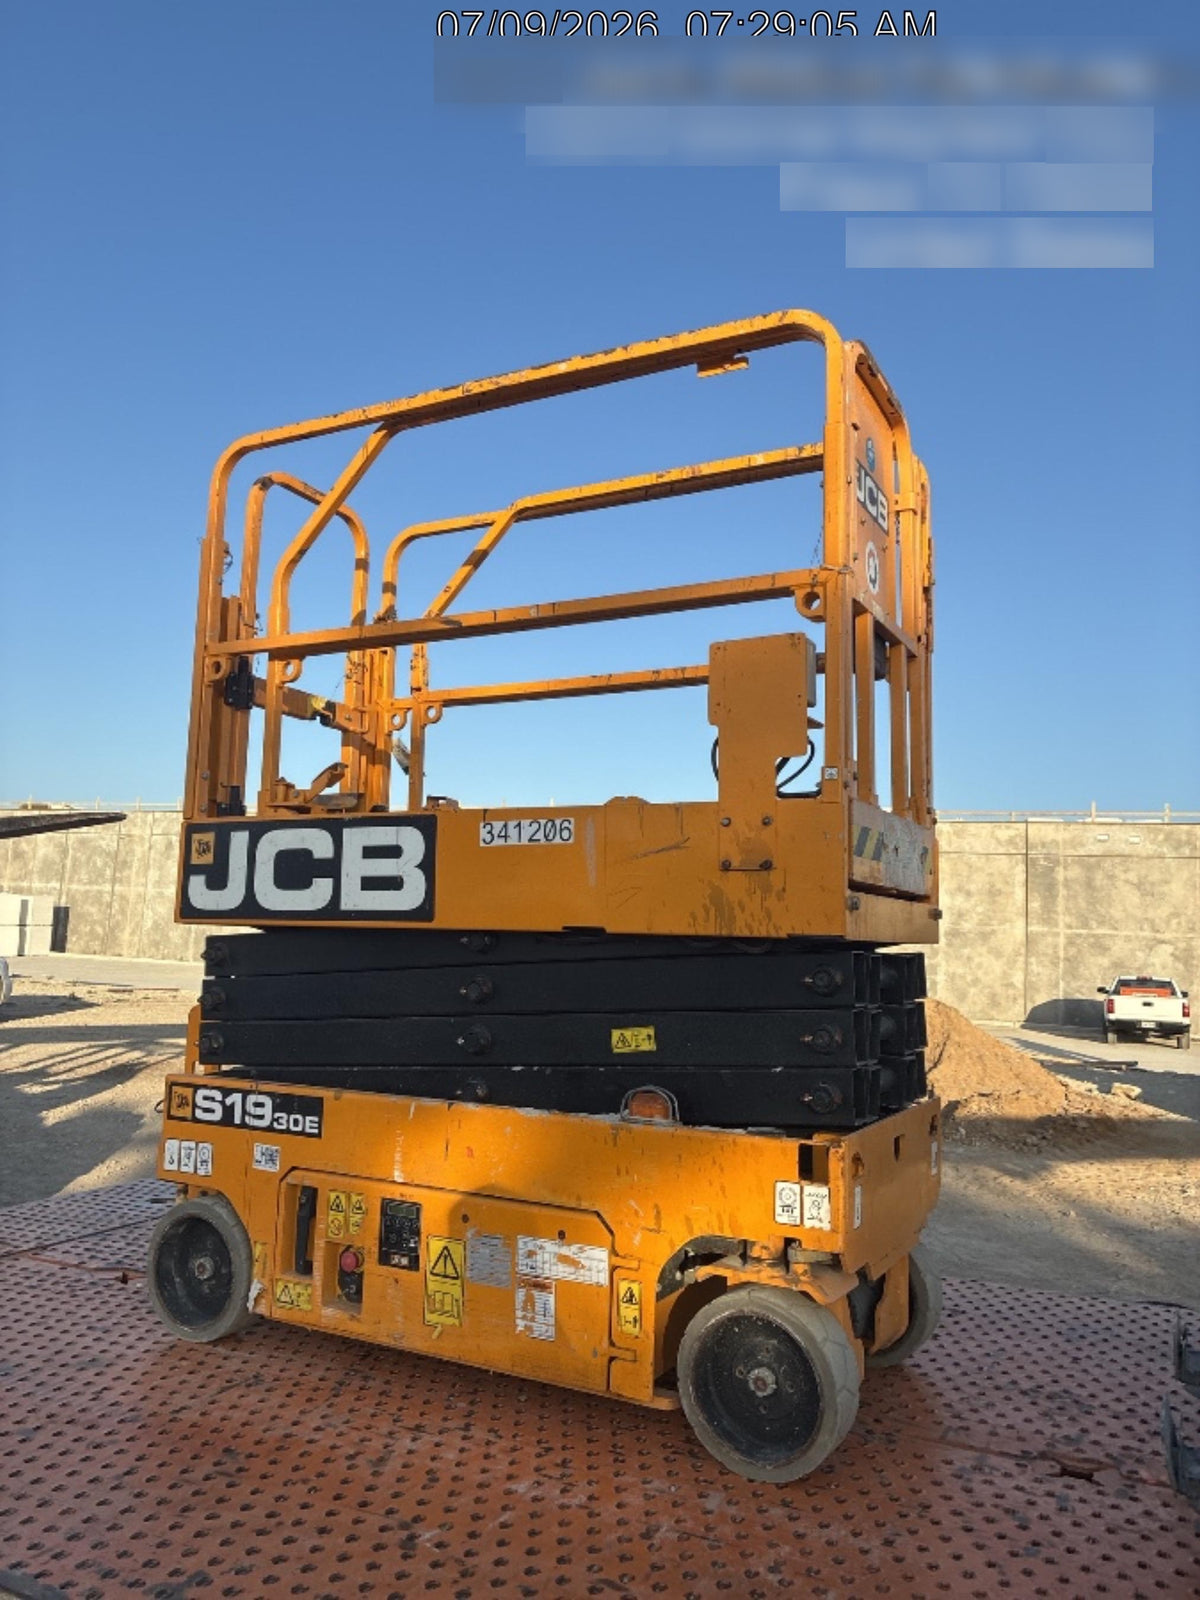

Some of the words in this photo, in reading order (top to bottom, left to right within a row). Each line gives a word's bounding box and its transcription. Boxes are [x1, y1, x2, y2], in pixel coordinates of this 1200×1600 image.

[857, 466, 888, 533] JCB
[482, 819, 573, 845] 341206
[187, 826, 427, 911] JCB
